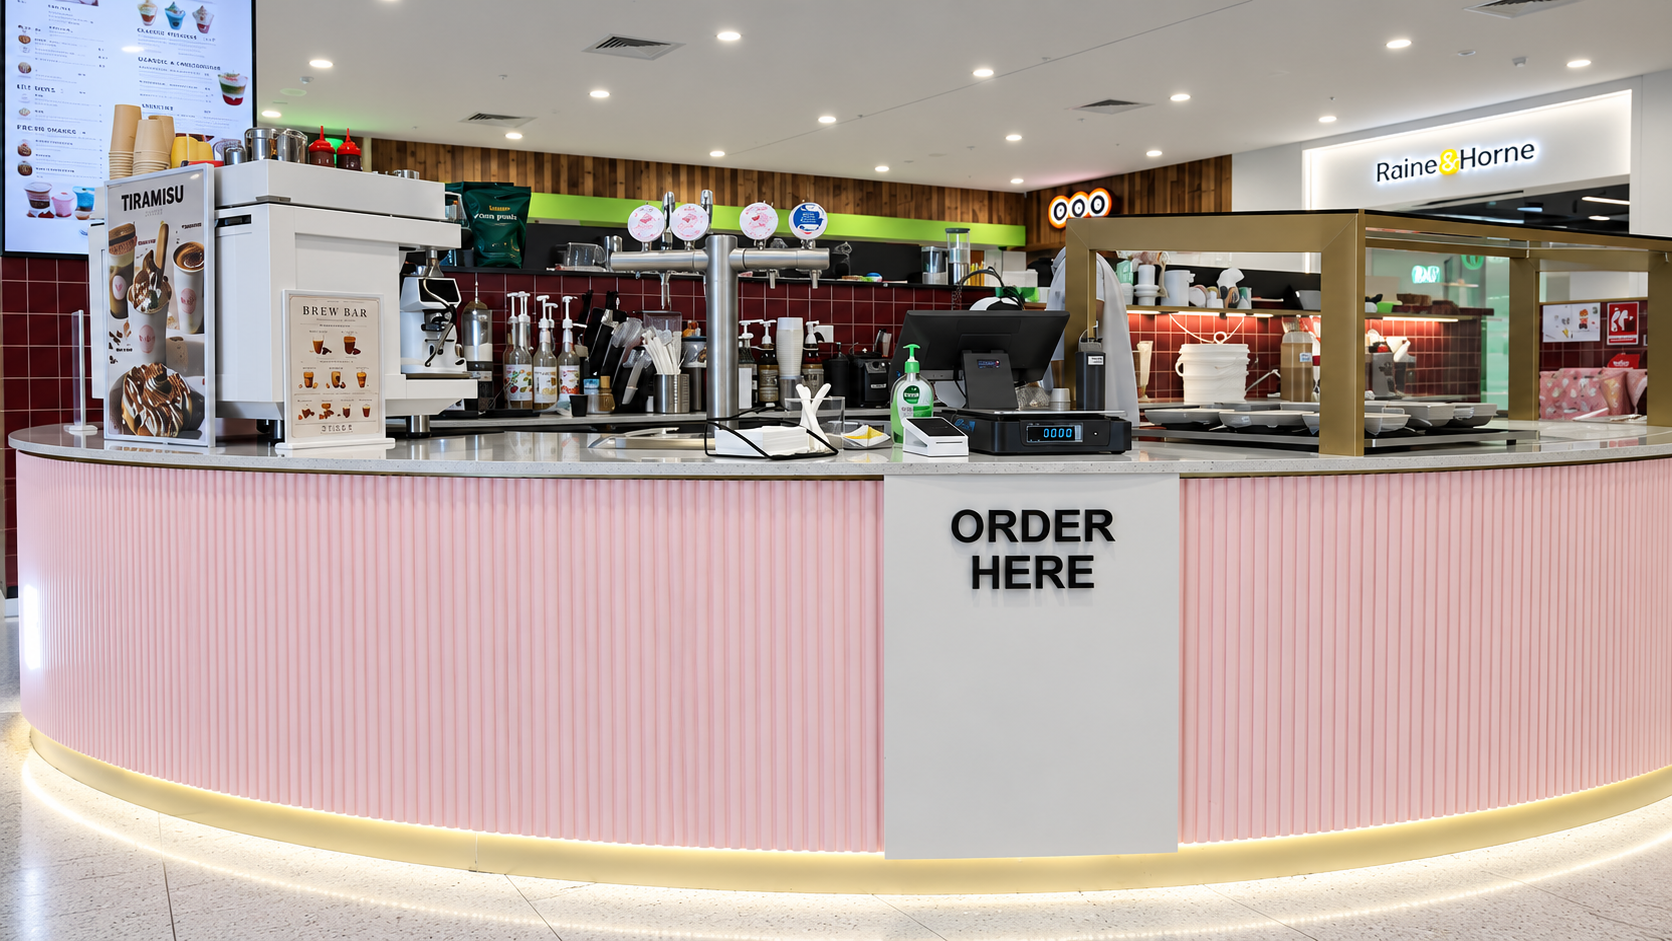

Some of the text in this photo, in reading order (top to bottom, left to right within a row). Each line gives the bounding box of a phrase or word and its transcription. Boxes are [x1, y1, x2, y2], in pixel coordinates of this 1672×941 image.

[121, 185, 184, 211] TIRAMISU
[303, 305, 368, 318] BREW BAR
[1043, 428, 1073, 439] 0000
[951, 509, 1115, 543] ORDER
[972, 555, 1094, 589] HERE
